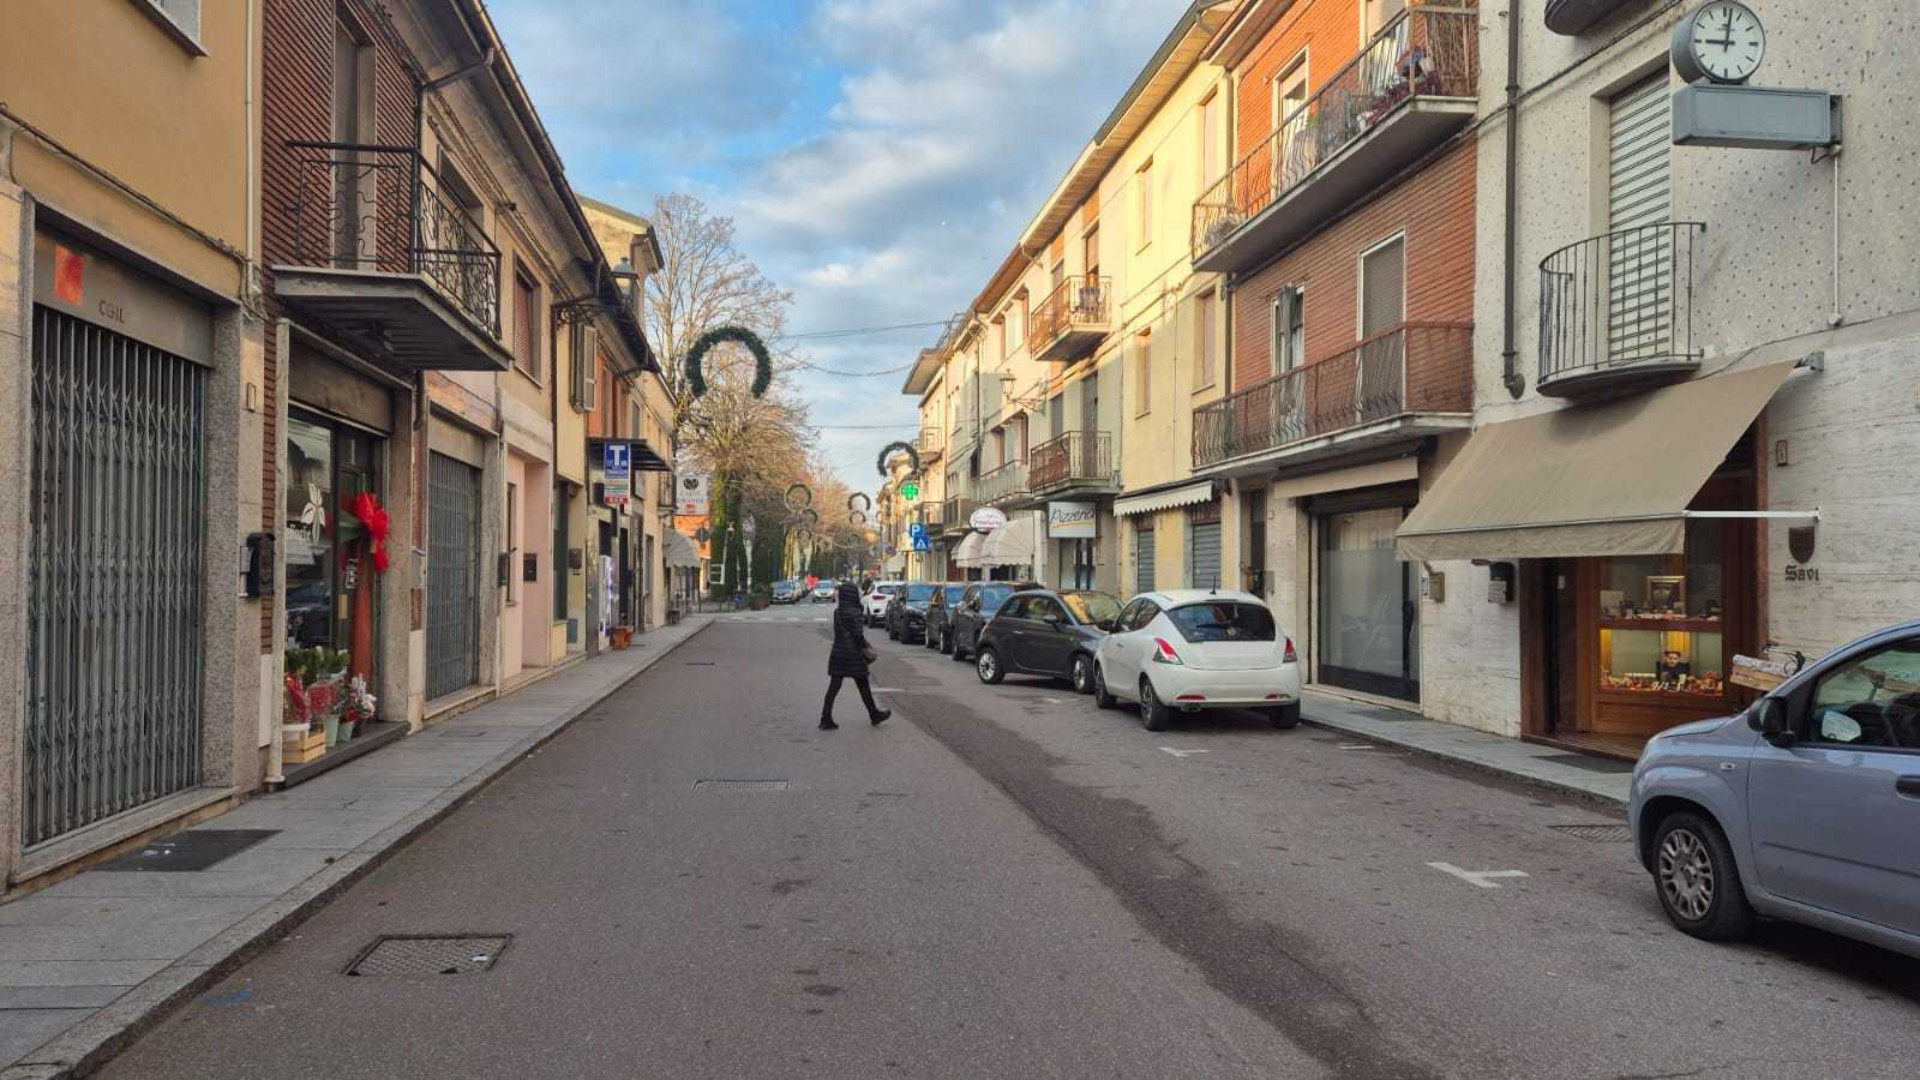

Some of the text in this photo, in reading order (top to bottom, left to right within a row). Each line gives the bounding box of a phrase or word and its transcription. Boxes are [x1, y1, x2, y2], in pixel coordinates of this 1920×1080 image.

[98, 299, 126, 324] CGIL
[609, 444, 626, 467] T
[911, 523, 921, 537] P
